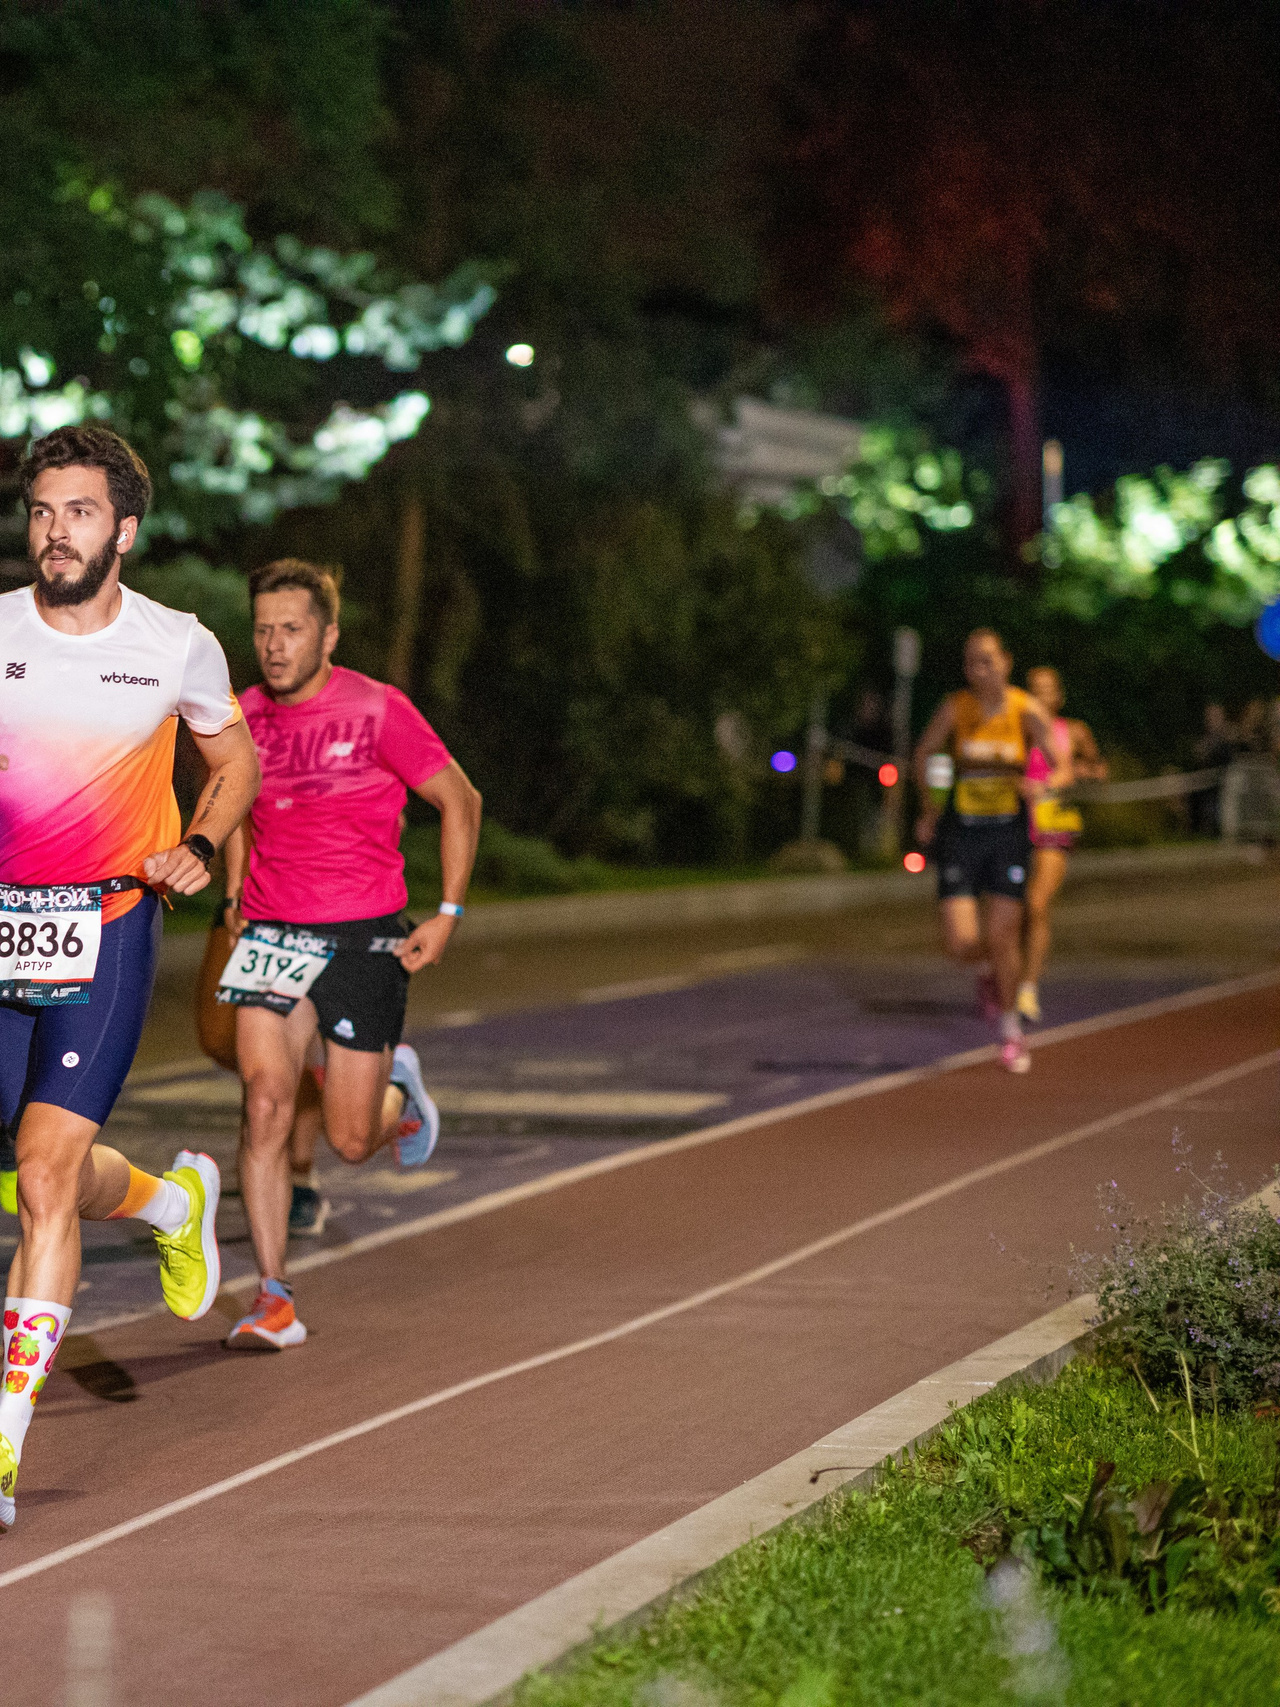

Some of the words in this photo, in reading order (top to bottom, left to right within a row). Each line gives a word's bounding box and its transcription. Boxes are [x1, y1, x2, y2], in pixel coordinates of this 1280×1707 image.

[100, 671, 159, 687] wbteam
[14, 961, 53, 971] АРТУР
[240, 949, 310, 983] 3194
